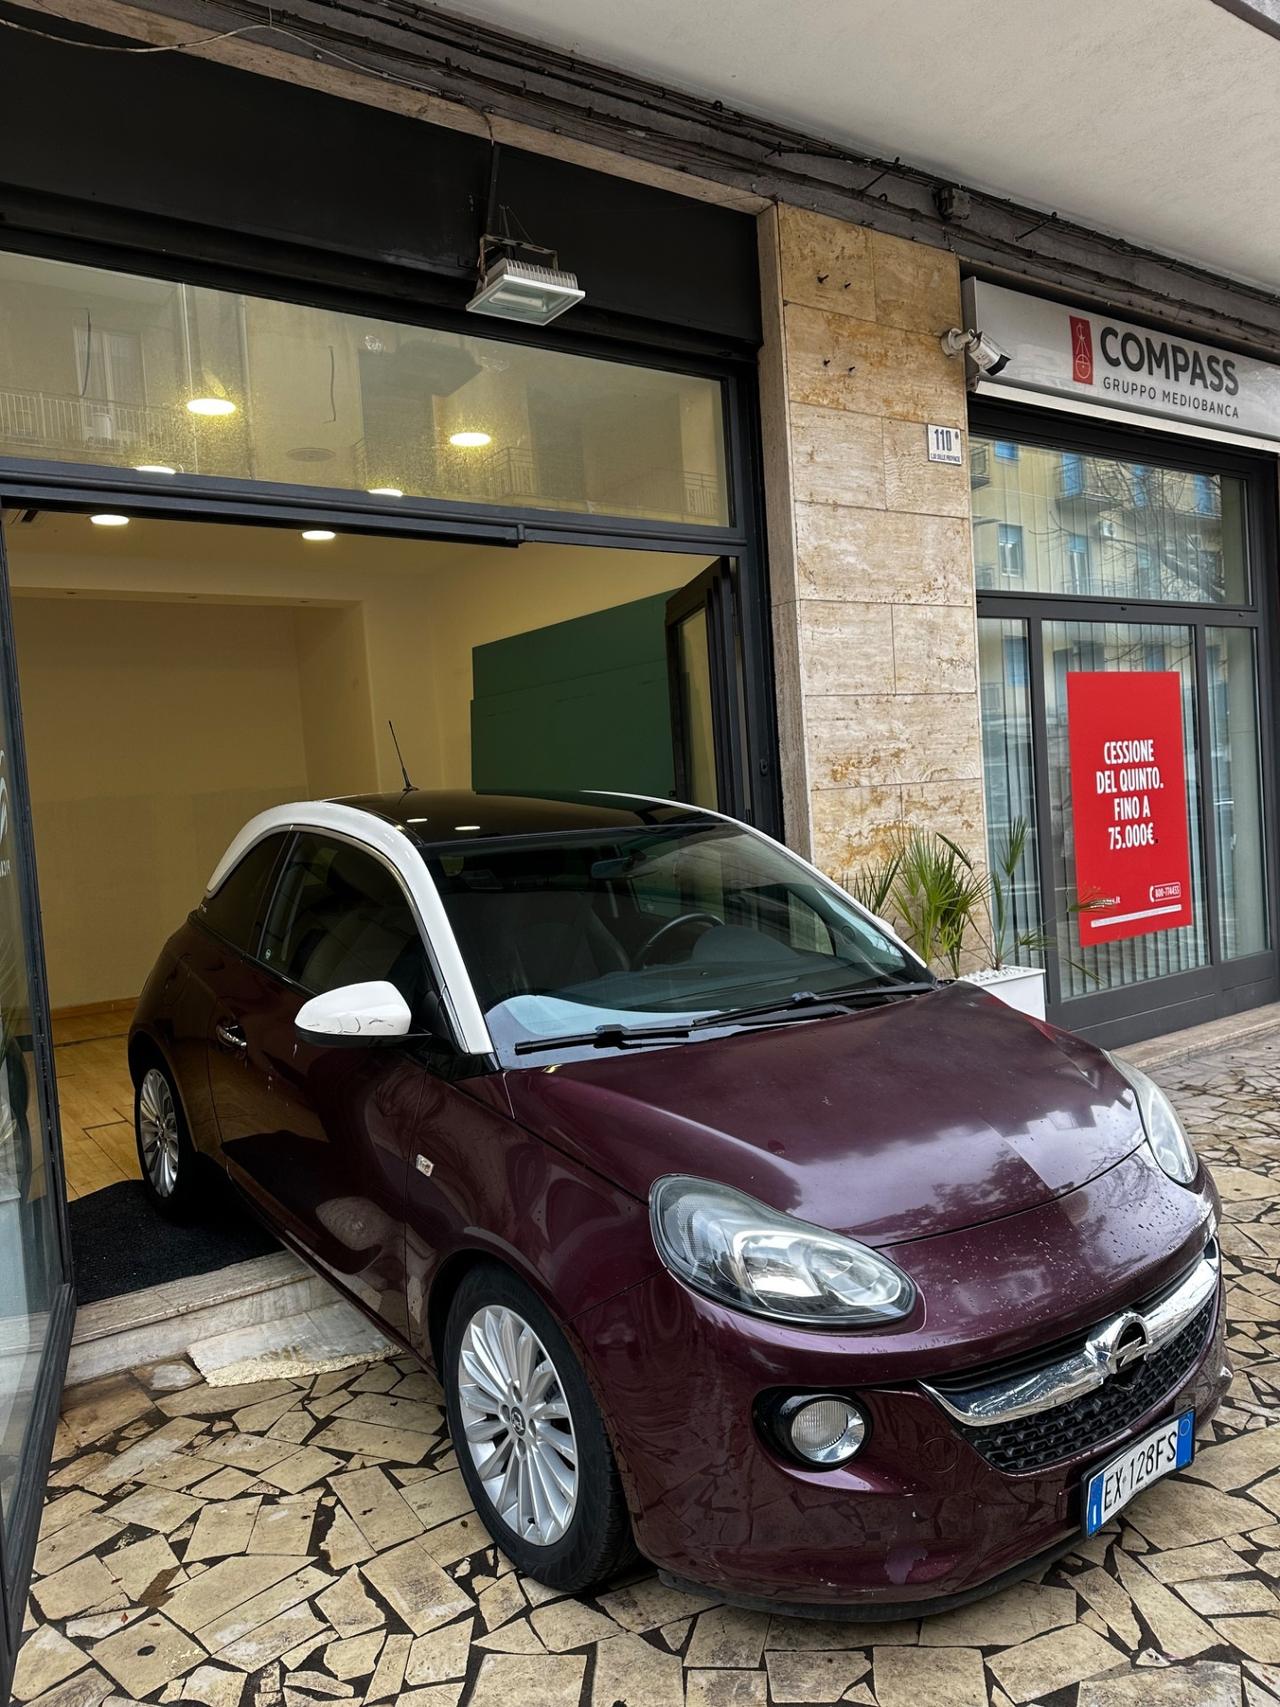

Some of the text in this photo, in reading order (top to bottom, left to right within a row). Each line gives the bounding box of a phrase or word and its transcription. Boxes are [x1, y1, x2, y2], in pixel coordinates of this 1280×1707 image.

[1100, 327, 1239, 396] COMPASS
[1103, 376, 1239, 419] GRUPPO MEDIOBANCA
[1104, 739, 1154, 765] CESSIONE
[1096, 767, 1164, 794] DEL QUINTO.
[1113, 795, 1151, 821] FINO A
[1108, 822, 1155, 850] 75.000€
